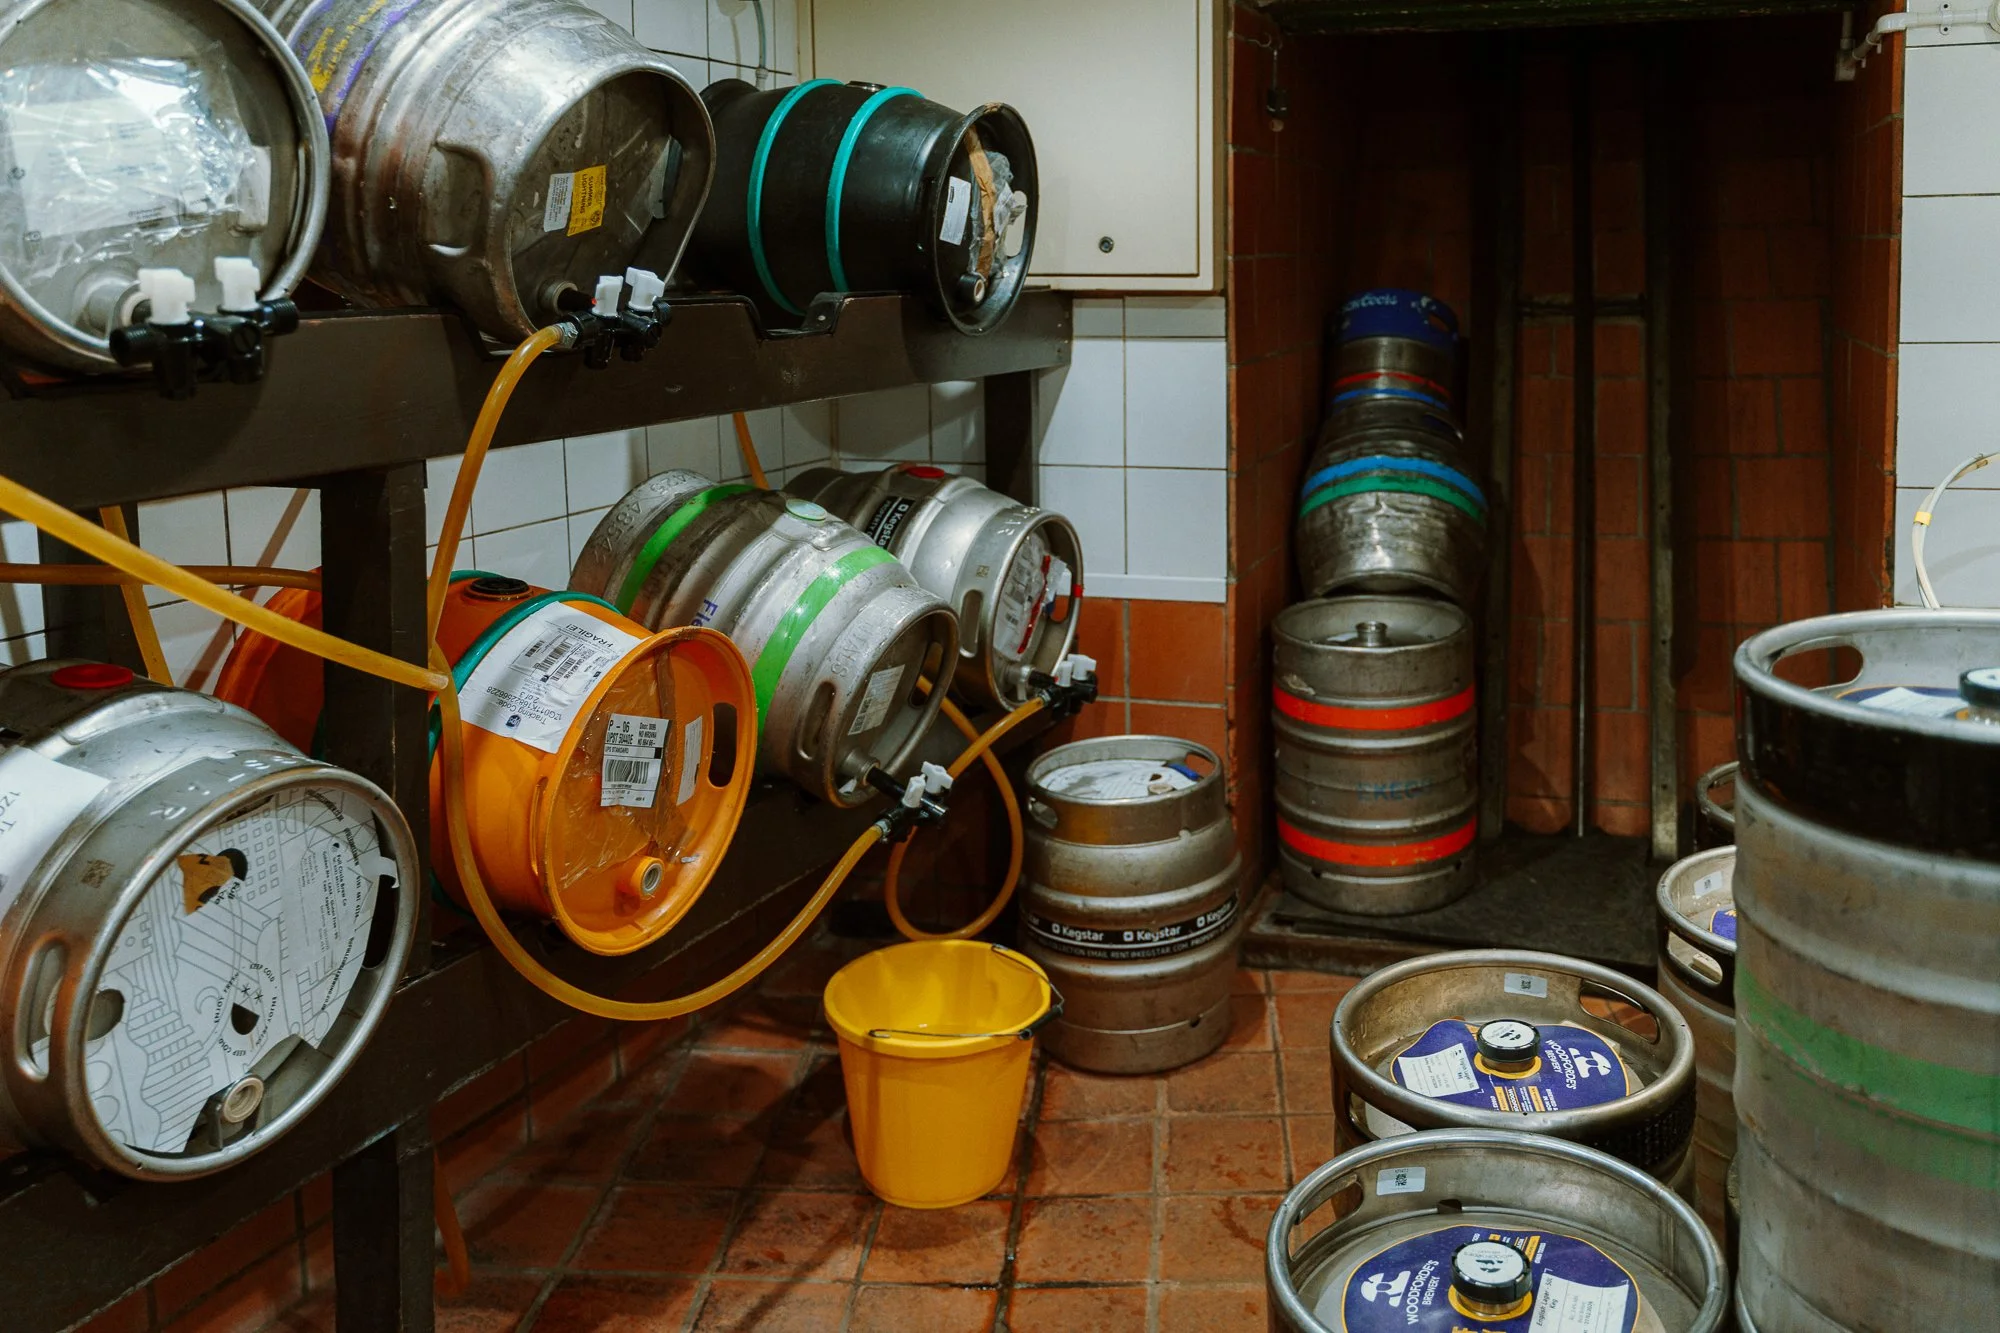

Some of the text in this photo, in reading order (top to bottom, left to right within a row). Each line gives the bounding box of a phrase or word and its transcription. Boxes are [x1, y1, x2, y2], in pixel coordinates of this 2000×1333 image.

[580, 173, 588, 214] LIGHTNING
[879, 513, 903, 546] Kegsta
[565, 623, 614, 648] FRAGILE!
[517, 707, 547, 725] Tracking
[608, 719, 614, 732] P
[622, 720, 630, 733] 06
[227, 881, 241, 900] Full
[1062, 927, 1105, 942] Kegstar
[1087, 950, 1109, 959] EMAIL
[263, 967, 276, 983] COLD
[213, 997, 225, 1024] ENJOY
[266, 996, 278, 1023] ENJOY
[218, 1037, 247, 1057] KEEP COLD
[1544, 1049, 1563, 1074] BREWERY
[1544, 1038, 1577, 1090] WOODFORDE'S
[1407, 1259, 1440, 1326] WOODFORDE'S
[1421, 1276, 1441, 1306] BREWERY
[1536, 1305, 1546, 1327] English
[1550, 1299, 1559, 1310] Keg
